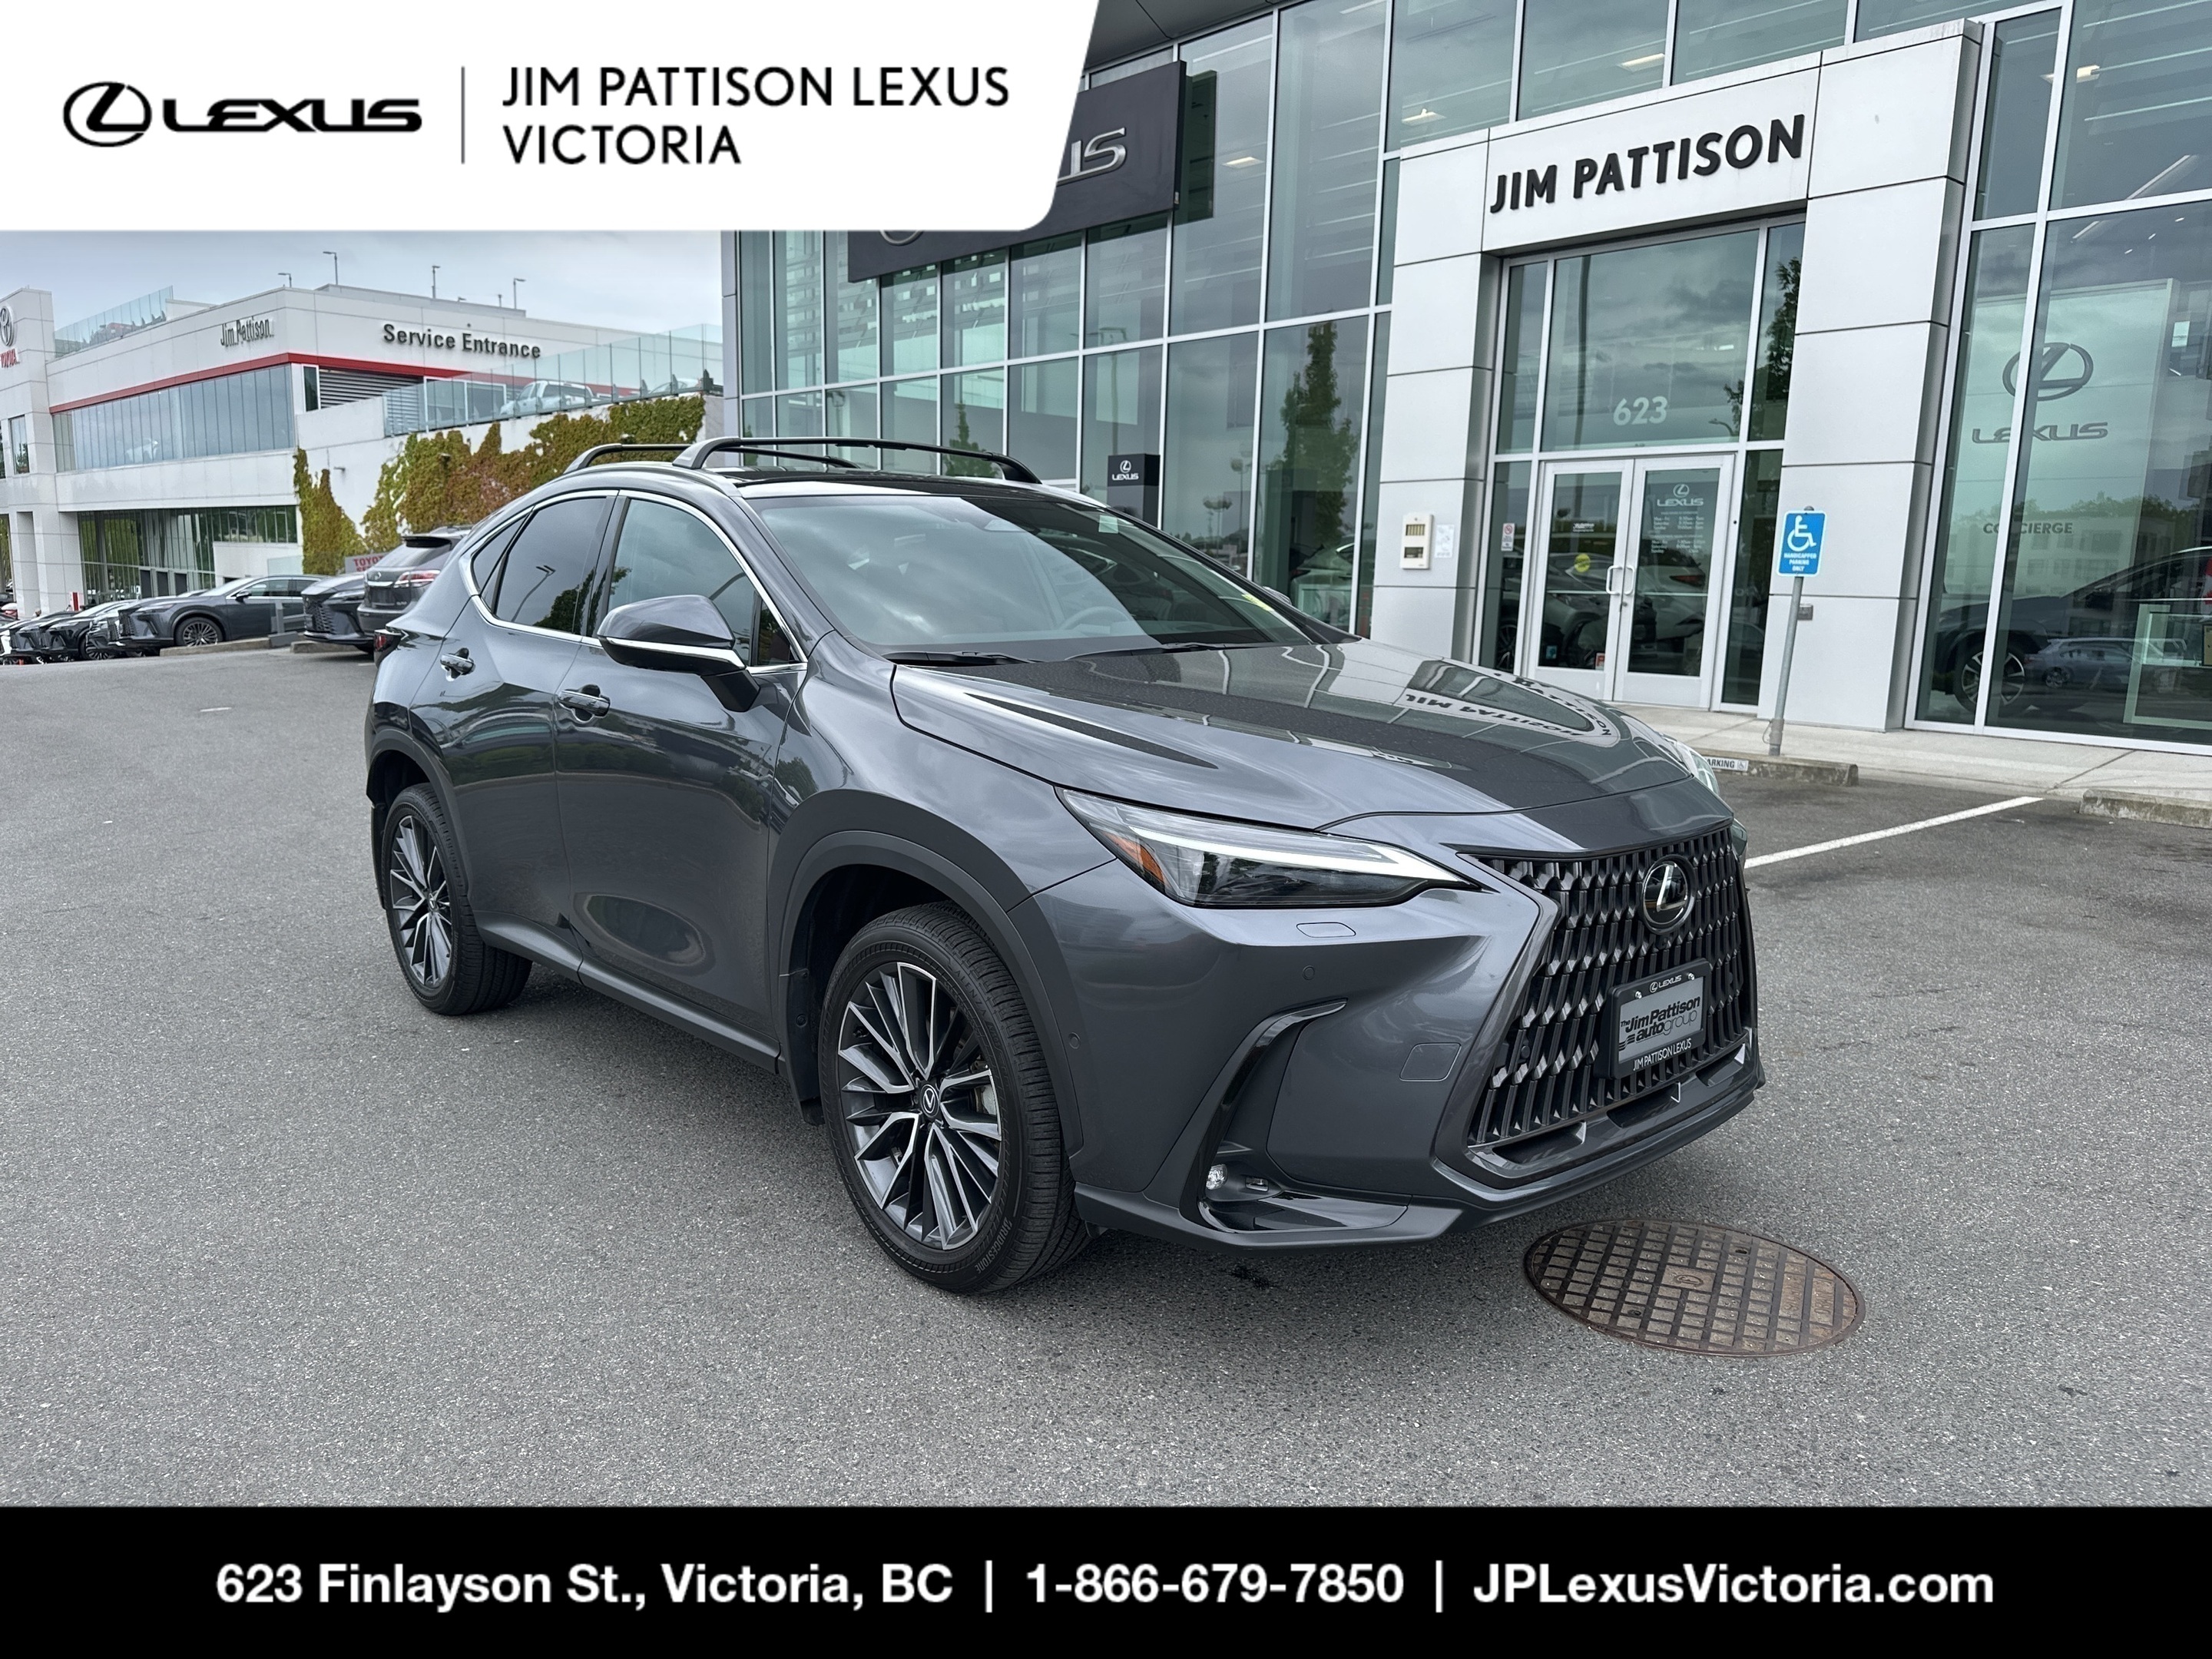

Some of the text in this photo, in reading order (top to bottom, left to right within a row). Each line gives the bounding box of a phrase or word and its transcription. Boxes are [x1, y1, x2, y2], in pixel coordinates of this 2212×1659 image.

[1490, 114, 1805, 214] JIM PATTISON
[220, 316, 270, 346] Jim Pattison
[383, 323, 541, 359] Service Entrance
[1613, 396, 1668, 426] 623
[1111, 472, 1139, 481] LEXUS
[1657, 498, 1704, 507] LEXUS
[1982, 522, 2073, 534] CCIERGE
[353, 555, 385, 567] TOYO
[1707, 757, 1736, 769] ARKING
[955, 970, 987, 1016] ALENZA
[1658, 975, 1683, 989] LEXUS
[1621, 996, 1700, 1033] The Jim Pattison
[1633, 1038, 1692, 1071] JIM PATTISON LEXUS
[975, 1217, 1012, 1273] BRIDGESTONE
